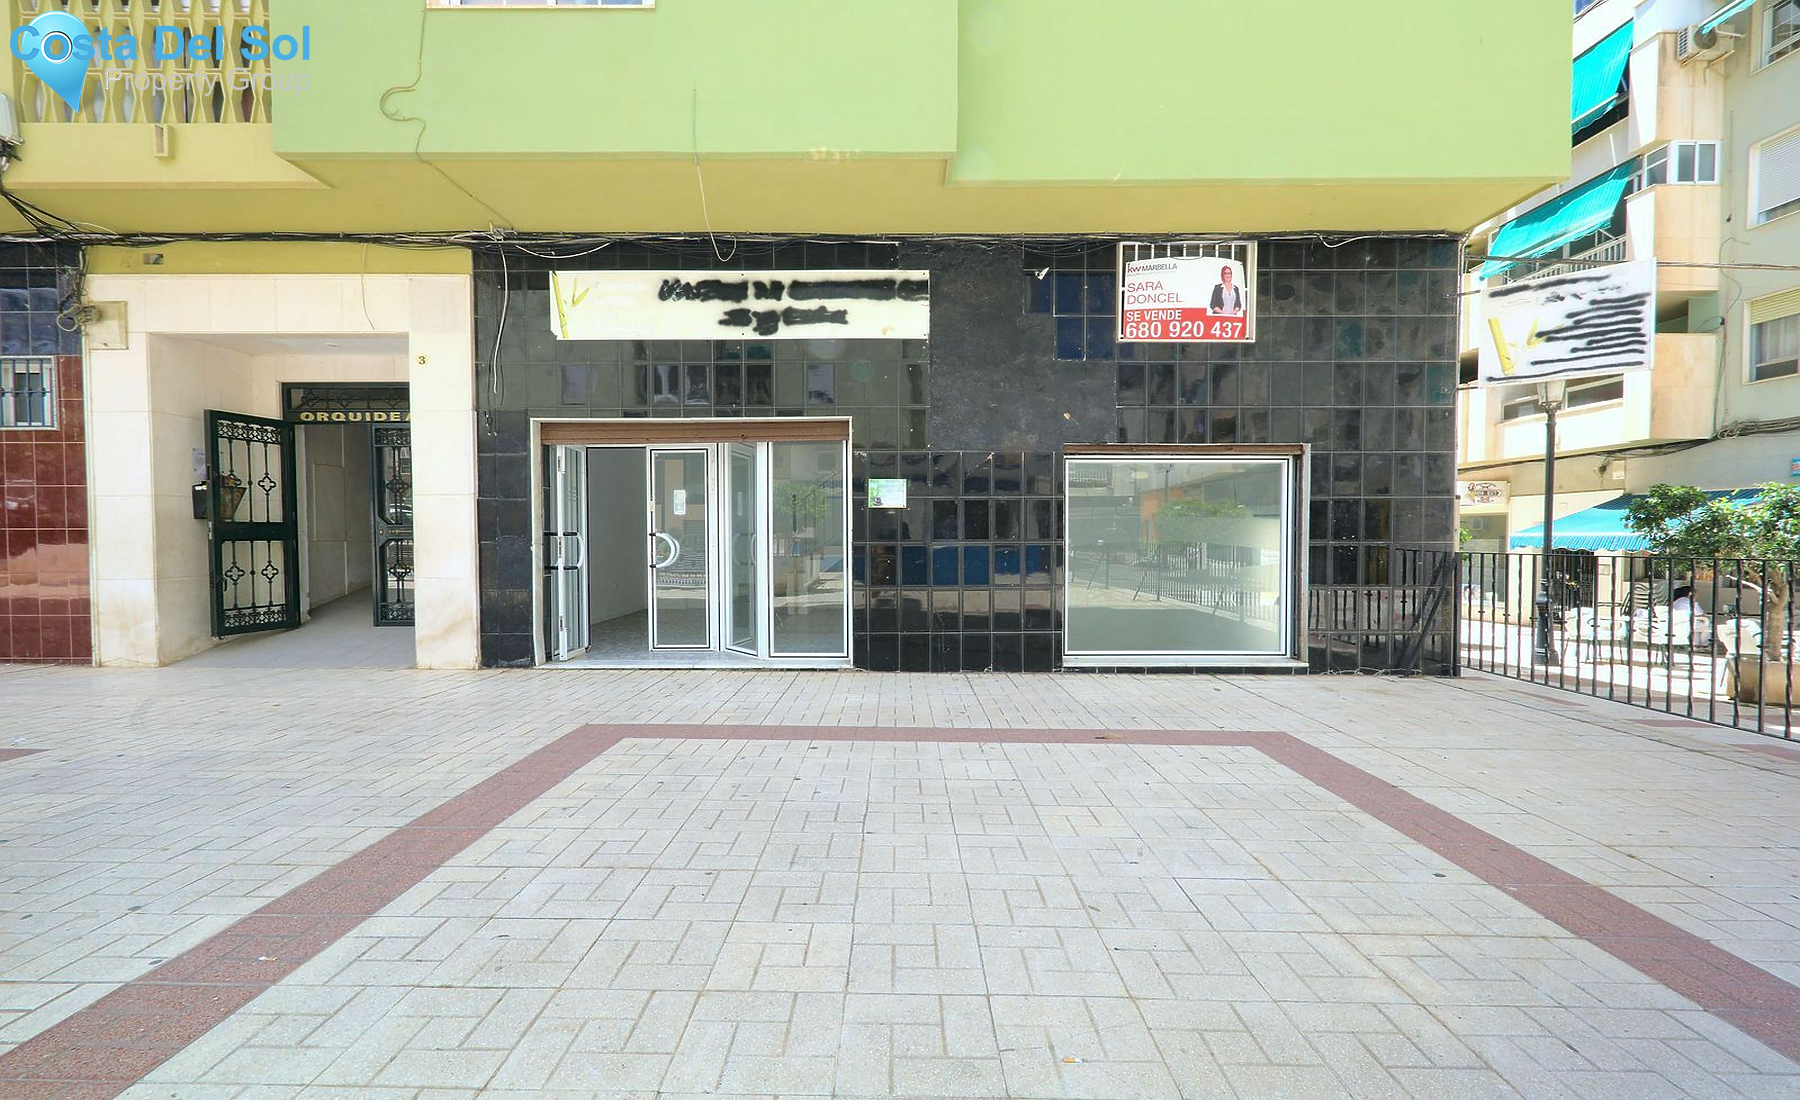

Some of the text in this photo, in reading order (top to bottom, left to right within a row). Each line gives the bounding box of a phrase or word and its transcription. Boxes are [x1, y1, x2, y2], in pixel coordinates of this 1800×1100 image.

[1127, 280, 1164, 293] SARA
[1127, 292, 1183, 305] DONCEL
[1126, 310, 1182, 322] SE VENDE
[1126, 321, 1243, 339] 680 920 437
[418, 355, 426, 365] 3
